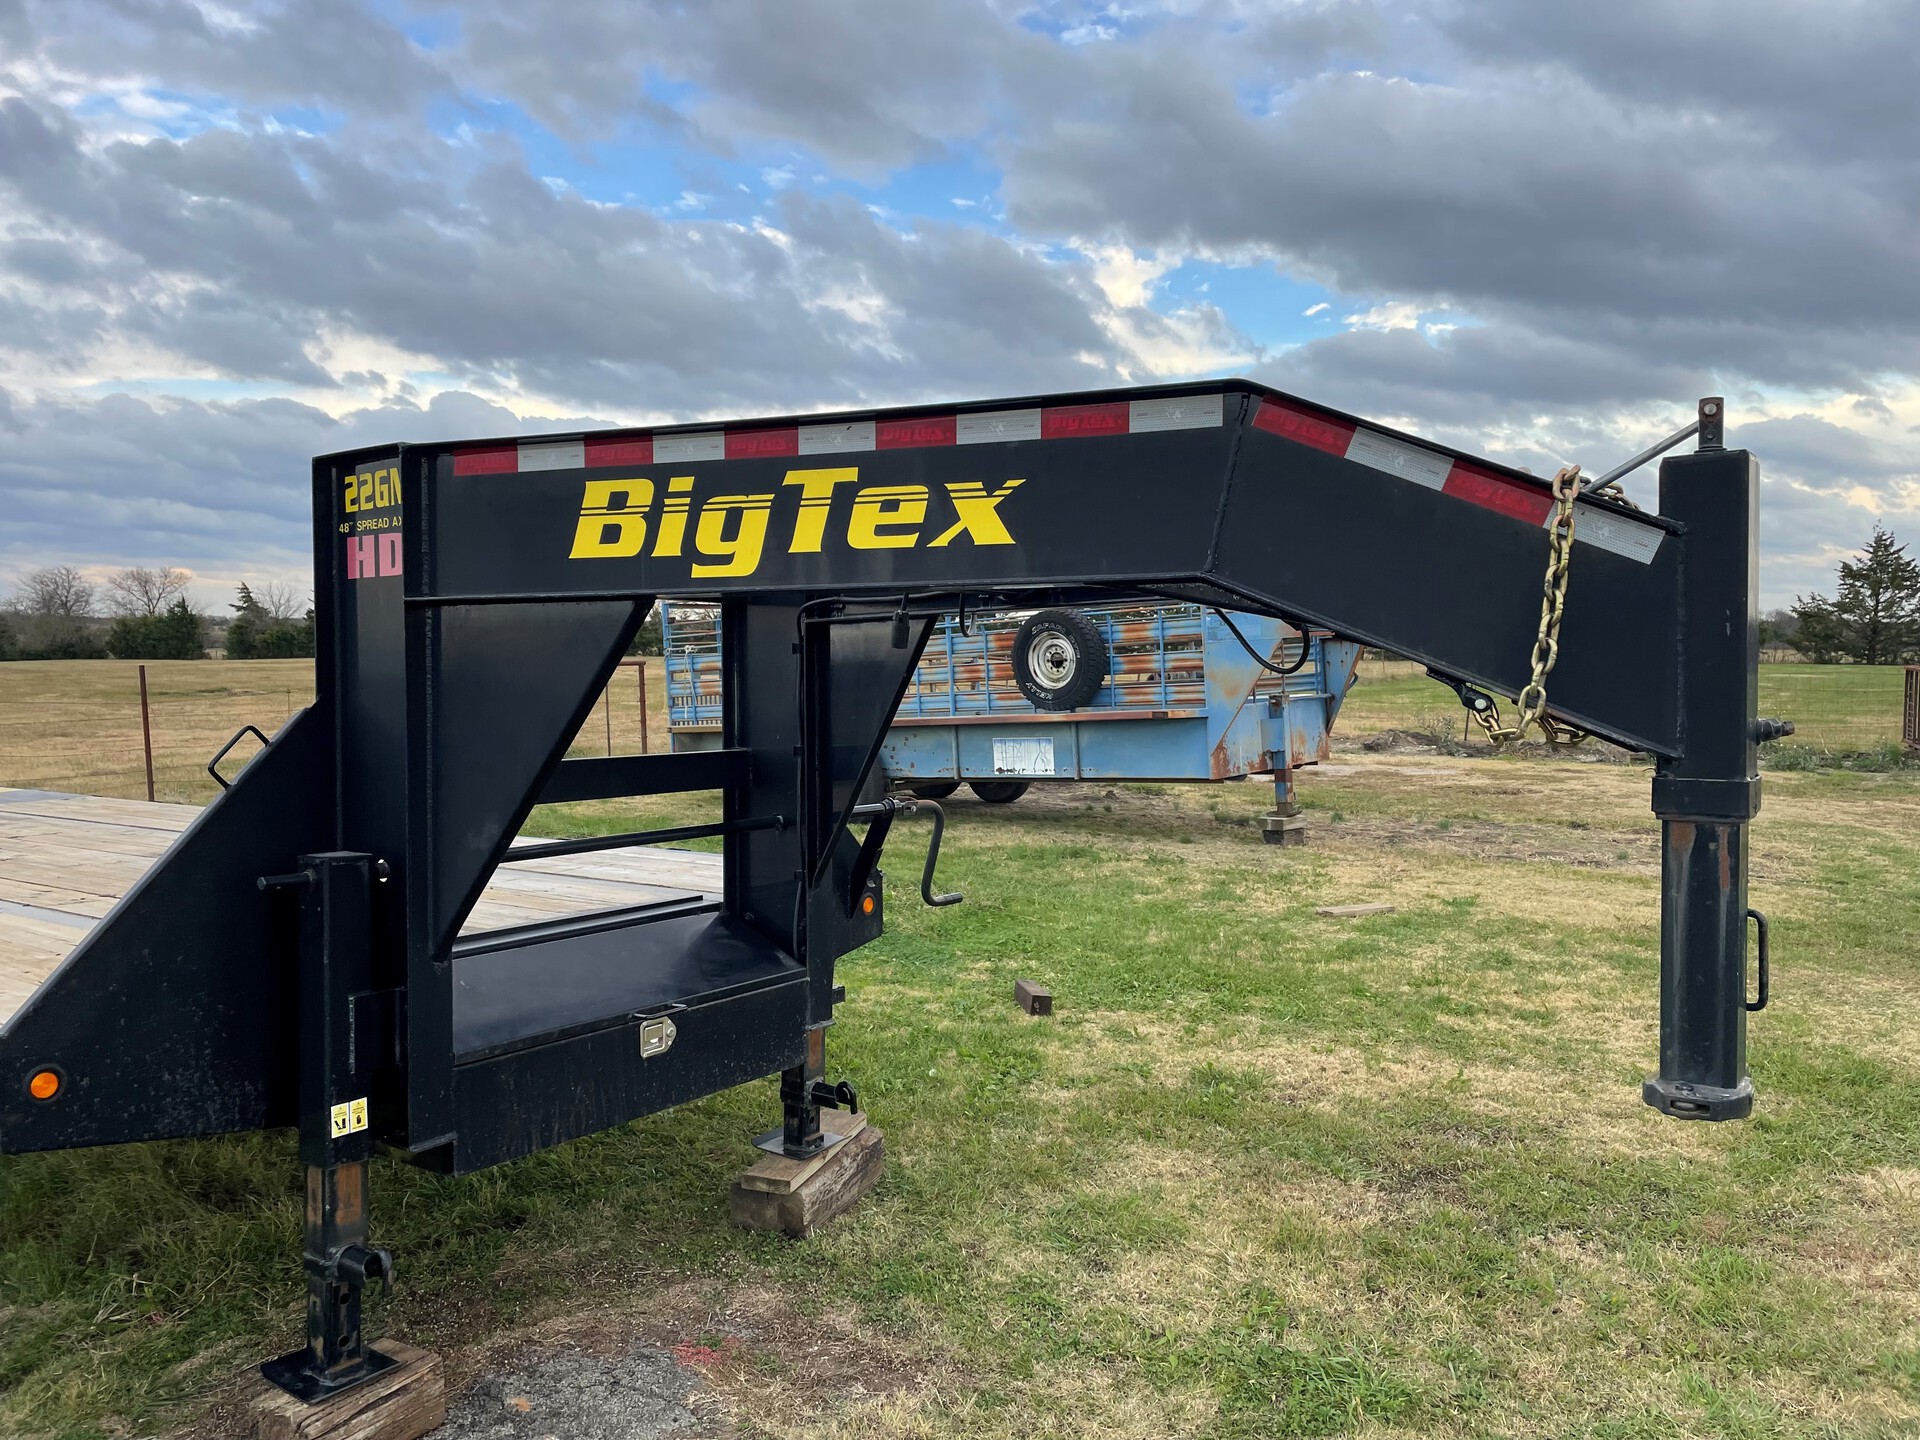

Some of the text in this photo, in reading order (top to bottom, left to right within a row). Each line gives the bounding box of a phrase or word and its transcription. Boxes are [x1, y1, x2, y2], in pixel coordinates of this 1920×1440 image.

[357, 518, 389, 531] SPREAD
[569, 466, 1027, 579] BigTex
[347, 533, 403, 580] HD
[1032, 623, 1066, 635] SAFARI
